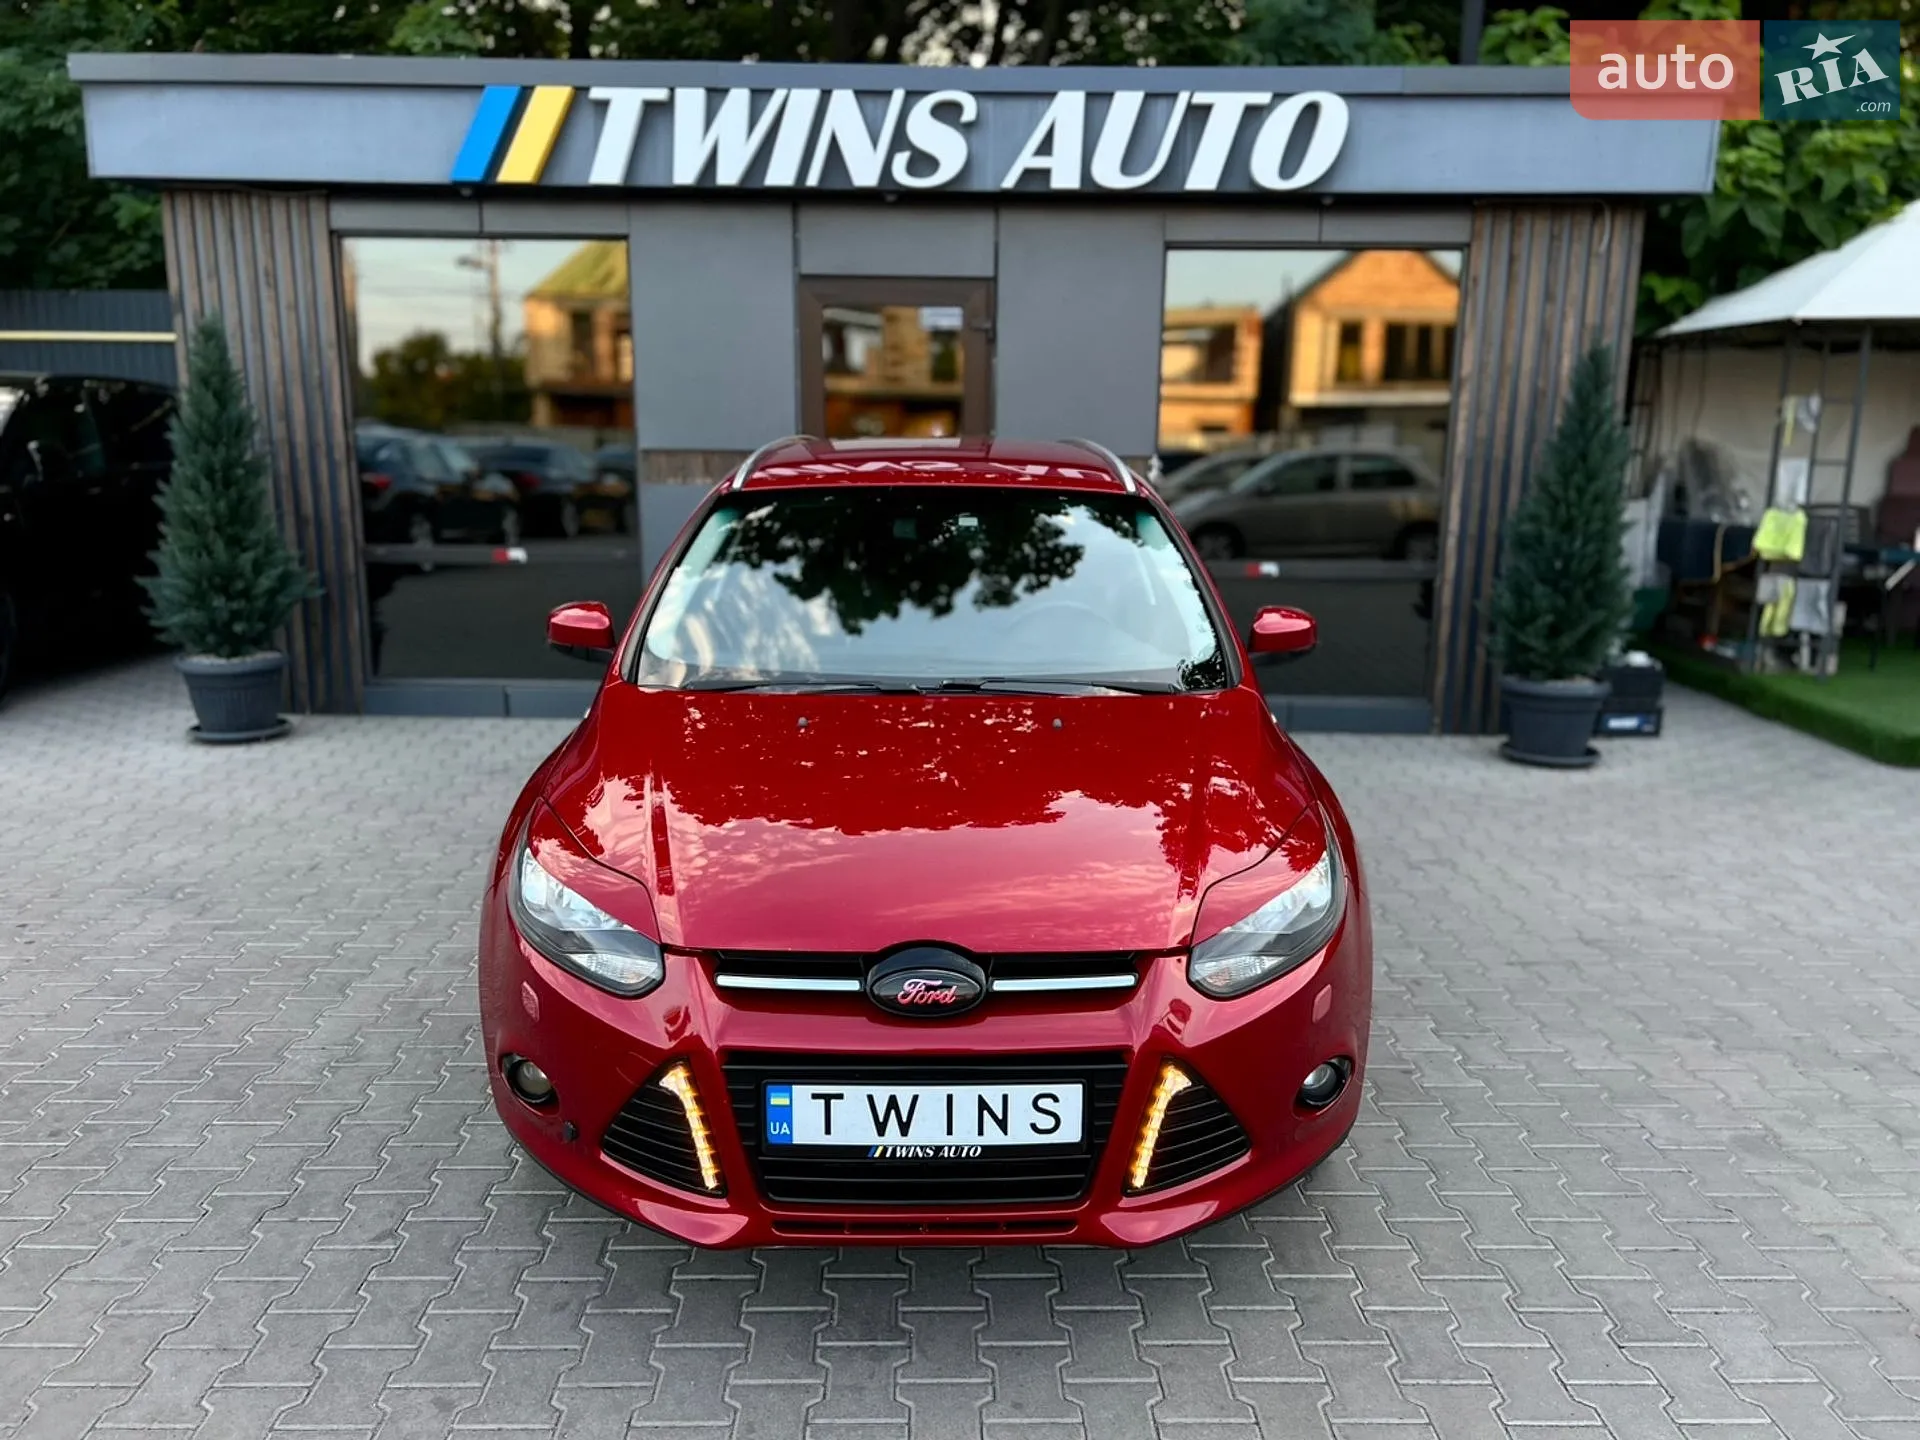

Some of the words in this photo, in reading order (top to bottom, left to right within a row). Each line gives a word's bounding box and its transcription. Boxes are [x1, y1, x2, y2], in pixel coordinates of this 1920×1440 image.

[588, 86, 979, 189] TWINS
[1000, 90, 1350, 191] AUTO
[898, 979, 957, 1004] Ford
[770, 1122, 790, 1135] UA
[811, 1092, 1062, 1137] TWINS
[885, 1145, 934, 1158] TWINS
[937, 1145, 982, 1158] AUTO
